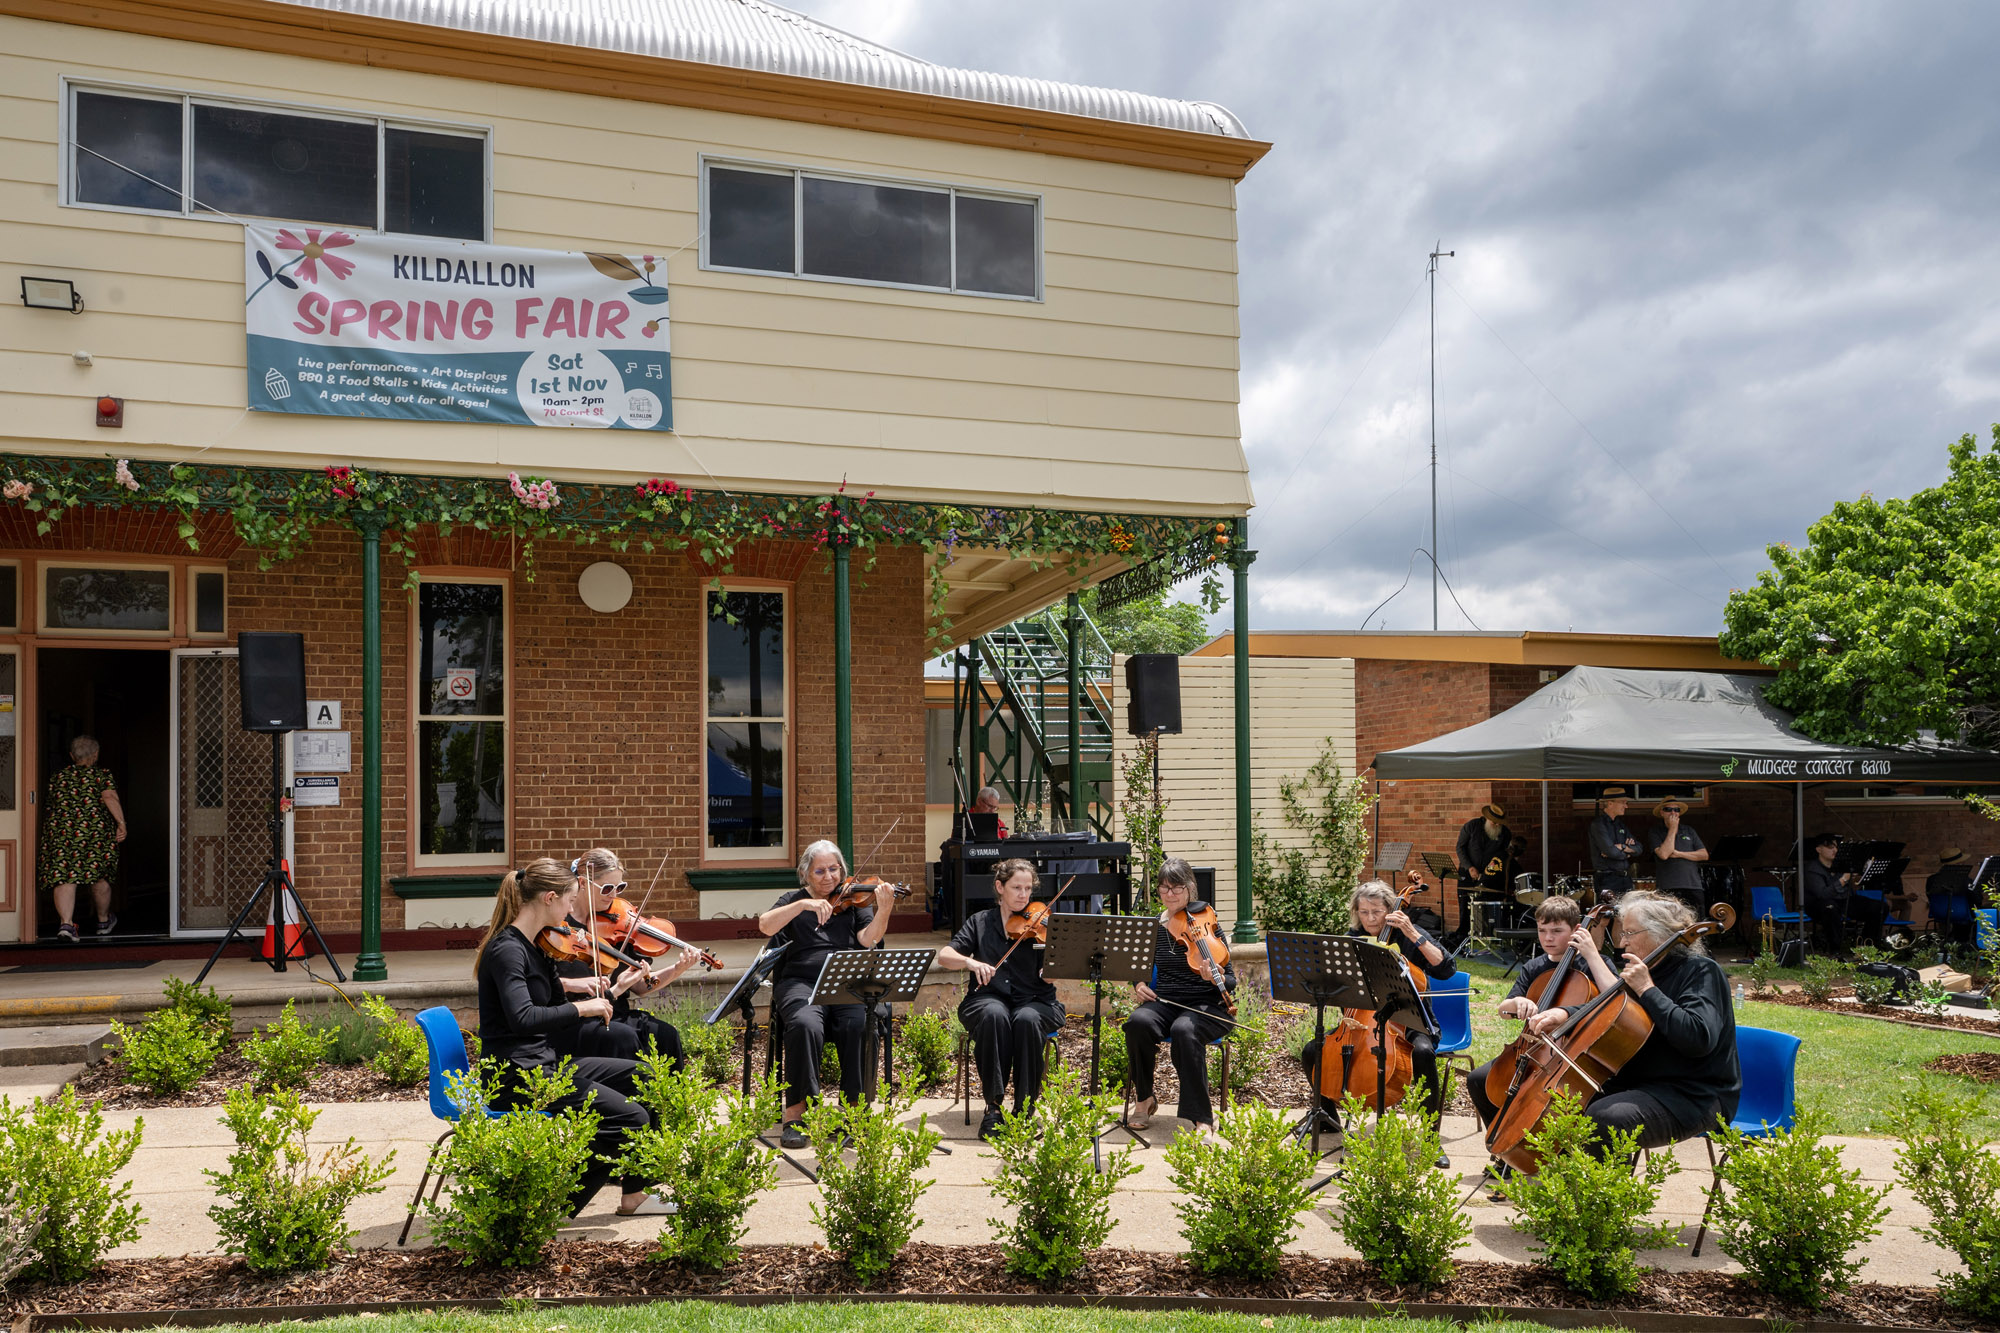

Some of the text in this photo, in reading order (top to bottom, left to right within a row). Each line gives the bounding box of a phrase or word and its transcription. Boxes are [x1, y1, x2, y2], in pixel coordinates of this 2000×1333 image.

[393, 254, 535, 288] KILDALLON
[292, 291, 630, 342] SPRING FAIR
[298, 357, 508, 383] Live performances Art Displays
[547, 352, 584, 371] Sat
[298, 371, 509, 395] BBQ & Food Stalls Kids Activities
[530, 375, 608, 394] 1st Nov
[320, 390, 490, 409] A great day out for all ages!
[542, 398, 571, 406] 10am
[581, 396, 604, 407] 2pm
[543, 407, 604, 417] 70 Court St
[317, 704, 333, 720] A
[976, 848, 1000, 856] YAMAHA
